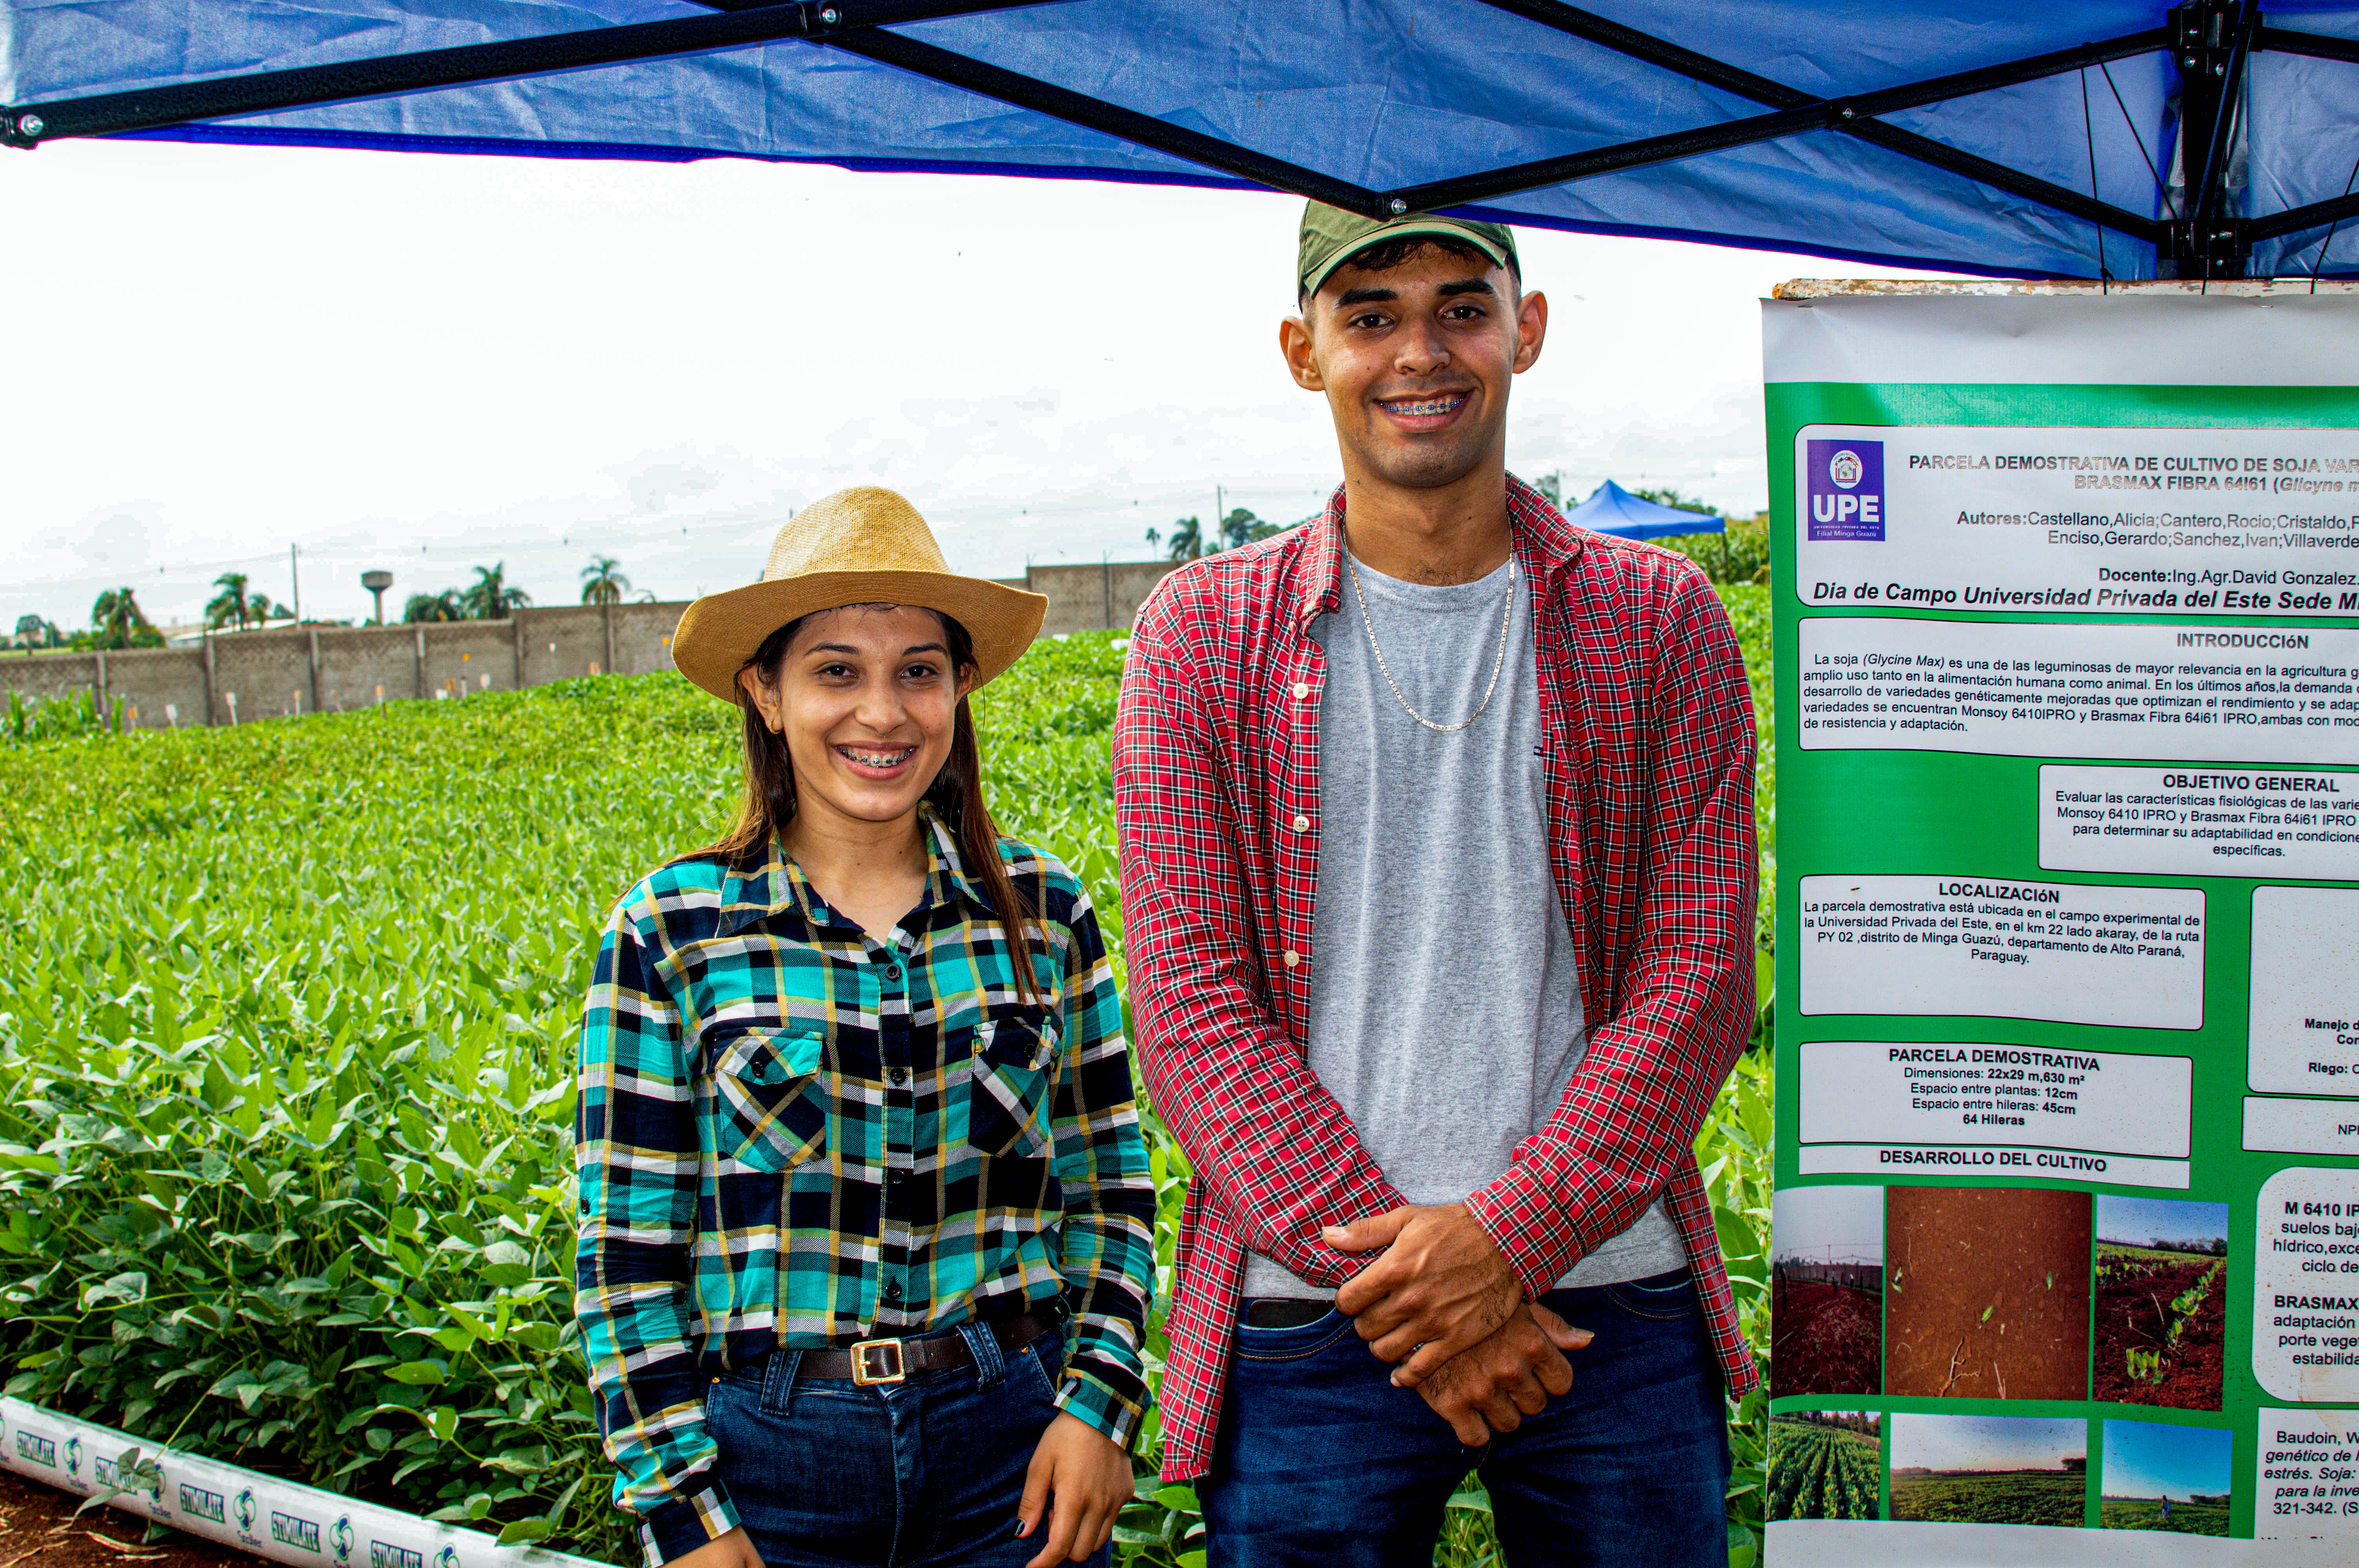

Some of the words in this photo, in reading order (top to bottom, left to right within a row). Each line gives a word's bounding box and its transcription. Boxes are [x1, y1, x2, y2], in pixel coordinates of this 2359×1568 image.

[1910, 455, 1990, 469] PARCELA
[1996, 456, 2129, 470] DEMOSTRATIVA
[2135, 457, 2158, 470] DE
[2164, 457, 2238, 471] CULTIVO
[2244, 458, 2267, 472] DE
[2273, 459, 2320, 472] SOJA
[2075, 475, 2161, 489] BRASMAX
[2168, 476, 2219, 490] FIBRA
[2274, 477, 2343, 494] (Glicyne
[1813, 494, 1879, 522] UPE
[2099, 568, 2276, 586] Docente:Ing.Agr.David
[1814, 583, 1846, 599] Dia
[1854, 583, 1879, 599] de
[1886, 583, 1957, 606] Campo
[1964, 587, 2092, 605] Universidad
[2097, 589, 2176, 606] Privada
[2185, 591, 2217, 607] del
[2223, 591, 2270, 608] Este
[2278, 592, 2331, 609] Sede
[1816, 654, 1828, 664] La
[1834, 654, 1857, 666] soja
[1864, 654, 1912, 666] (Glycine
[1916, 656, 1944, 669] Max)
[1994, 660, 2008, 670] de
[2013, 661, 2030, 671] las
[2035, 661, 2111, 674] leguminosas
[2116, 662, 2131, 673] de
[2136, 665, 2174, 676] mayor
[2179, 664, 2241, 675] relevancia
[2266, 665, 2276, 675] la
[2281, 666, 2346, 678] agricultura
[1805, 719, 1818, 728] de
[1823, 718, 1886, 728] resistencia
[1890, 720, 1896, 730] y
[1901, 719, 1967, 731] adaptación.
[2163, 775, 2249, 789] OBJETIVO
[2255, 777, 2340, 792] GENERAL
[2056, 791, 2102, 802] Evaluar
[2106, 793, 2123, 803] las
[2127, 795, 2215, 805] características
[2219, 796, 2286, 809] fisiológicas
[2291, 798, 2305, 808] de
[2310, 798, 2327, 809] las
[2058, 807, 2105, 821] Monsoy
[2109, 809, 2139, 819] 6410
[2144, 809, 2176, 820] IPRO
[2181, 813, 2187, 823] y
[2192, 811, 2245, 822] Brasmax
[2250, 813, 2280, 823] Fibra
[2284, 814, 2316, 824] 64i61
[2323, 815, 2356, 826] IPRO
[2073, 826, 2099, 836] para
[2104, 825, 2169, 836] determinar
[2191, 828, 2273, 840] adaptabilidad
[2213, 845, 2284, 857] específicas.
[1805, 902, 1818, 911] La
[1823, 901, 1865, 913] parcela
[1870, 901, 1945, 911] demostrativa
[1950, 903, 1974, 912] está
[1979, 904, 2023, 916] ubicada
[2046, 909, 2055, 918] el
[2059, 912, 2099, 923] campo
[2103, 913, 2181, 925] experimental
[2185, 915, 2199, 925] de
[1806, 918, 1814, 927] la
[1819, 916, 1887, 927] Universidad
[1892, 917, 1936, 927] Privada
[1941, 917, 1957, 927] del
[1963, 918, 1991, 930] Este,
[2014, 922, 2023, 931] el
[2028, 923, 2044, 933] km
[2049, 924, 2063, 935] 22
[2067, 926, 2092, 936] lado
[2096, 927, 2138, 941] akaray,
[2143, 929, 2157, 940] de
[2162, 930, 2172, 940] la
[2176, 932, 2198, 941] ruta
[1818, 932, 1834, 942] PY
[1839, 932, 1853, 942] 02
[1904, 933, 1917, 942] de
[1923, 933, 1957, 945] Minga
[1962, 933, 2003, 947] Guazú,
[2008, 936, 2089, 952] departamento
[2093, 943, 2107, 953] de
[2110, 944, 2134, 954] Alto
[2138, 945, 2184, 958] Paraná,
[1972, 949, 2029, 964] Paraguay.
[2305, 1018, 2349, 1031] Manejo
[1890, 1049, 1967, 1062] PARCELA
[1972, 1050, 2100, 1071] DEMOSTRATIVA
[1905, 1067, 1983, 1078] Dimensiones:
[1988, 1069, 2023, 1080] 22x29
[2028, 1073, 2065, 1083] m,630
[2069, 1076, 2085, 1085] m²
[1911, 1083, 1957, 1095] Espacio
[1961, 1084, 1991, 1093] entre
[1996, 1085, 2039, 1096] plantas:
[2045, 1087, 2077, 1100] 12cm
[1913, 1098, 1959, 1111] Espacio
[1963, 1100, 1992, 1109] entre
[1997, 1100, 2038, 1111] hileras:
[2043, 1102, 2075, 1114] 45cm
[1963, 1114, 1977, 1124] 64
[1982, 1114, 2025, 1125] Hileras
[1881, 1151, 1994, 1164] DESARROLLO
[2000, 1152, 2031, 1165] DEL
[2037, 1154, 2107, 1171] CULTIVO
[2285, 1201, 2298, 1214] M
[2304, 1202, 2341, 1216] 6410
[2281, 1222, 2329, 1234] suelos
[2302, 1259, 2337, 1272] ciclo
[2341, 1261, 2359, 1272] de
[2275, 1295, 2359, 1310] BRASMAX
[2274, 1314, 2355, 1330] adaptación
[2279, 1334, 2316, 1347] porte
[2277, 1431, 2341, 1445] Baudoin,
[2266, 1450, 2328, 1463] genético
[2333, 1450, 2351, 1461] de
[2264, 1468, 2312, 1479] estrés.
[2319, 1468, 2355, 1481] Soja:
[2275, 1488, 2308, 1499] para
[2313, 1485, 2326, 1497] la
[2274, 1503, 2337, 1514] 321-342.
